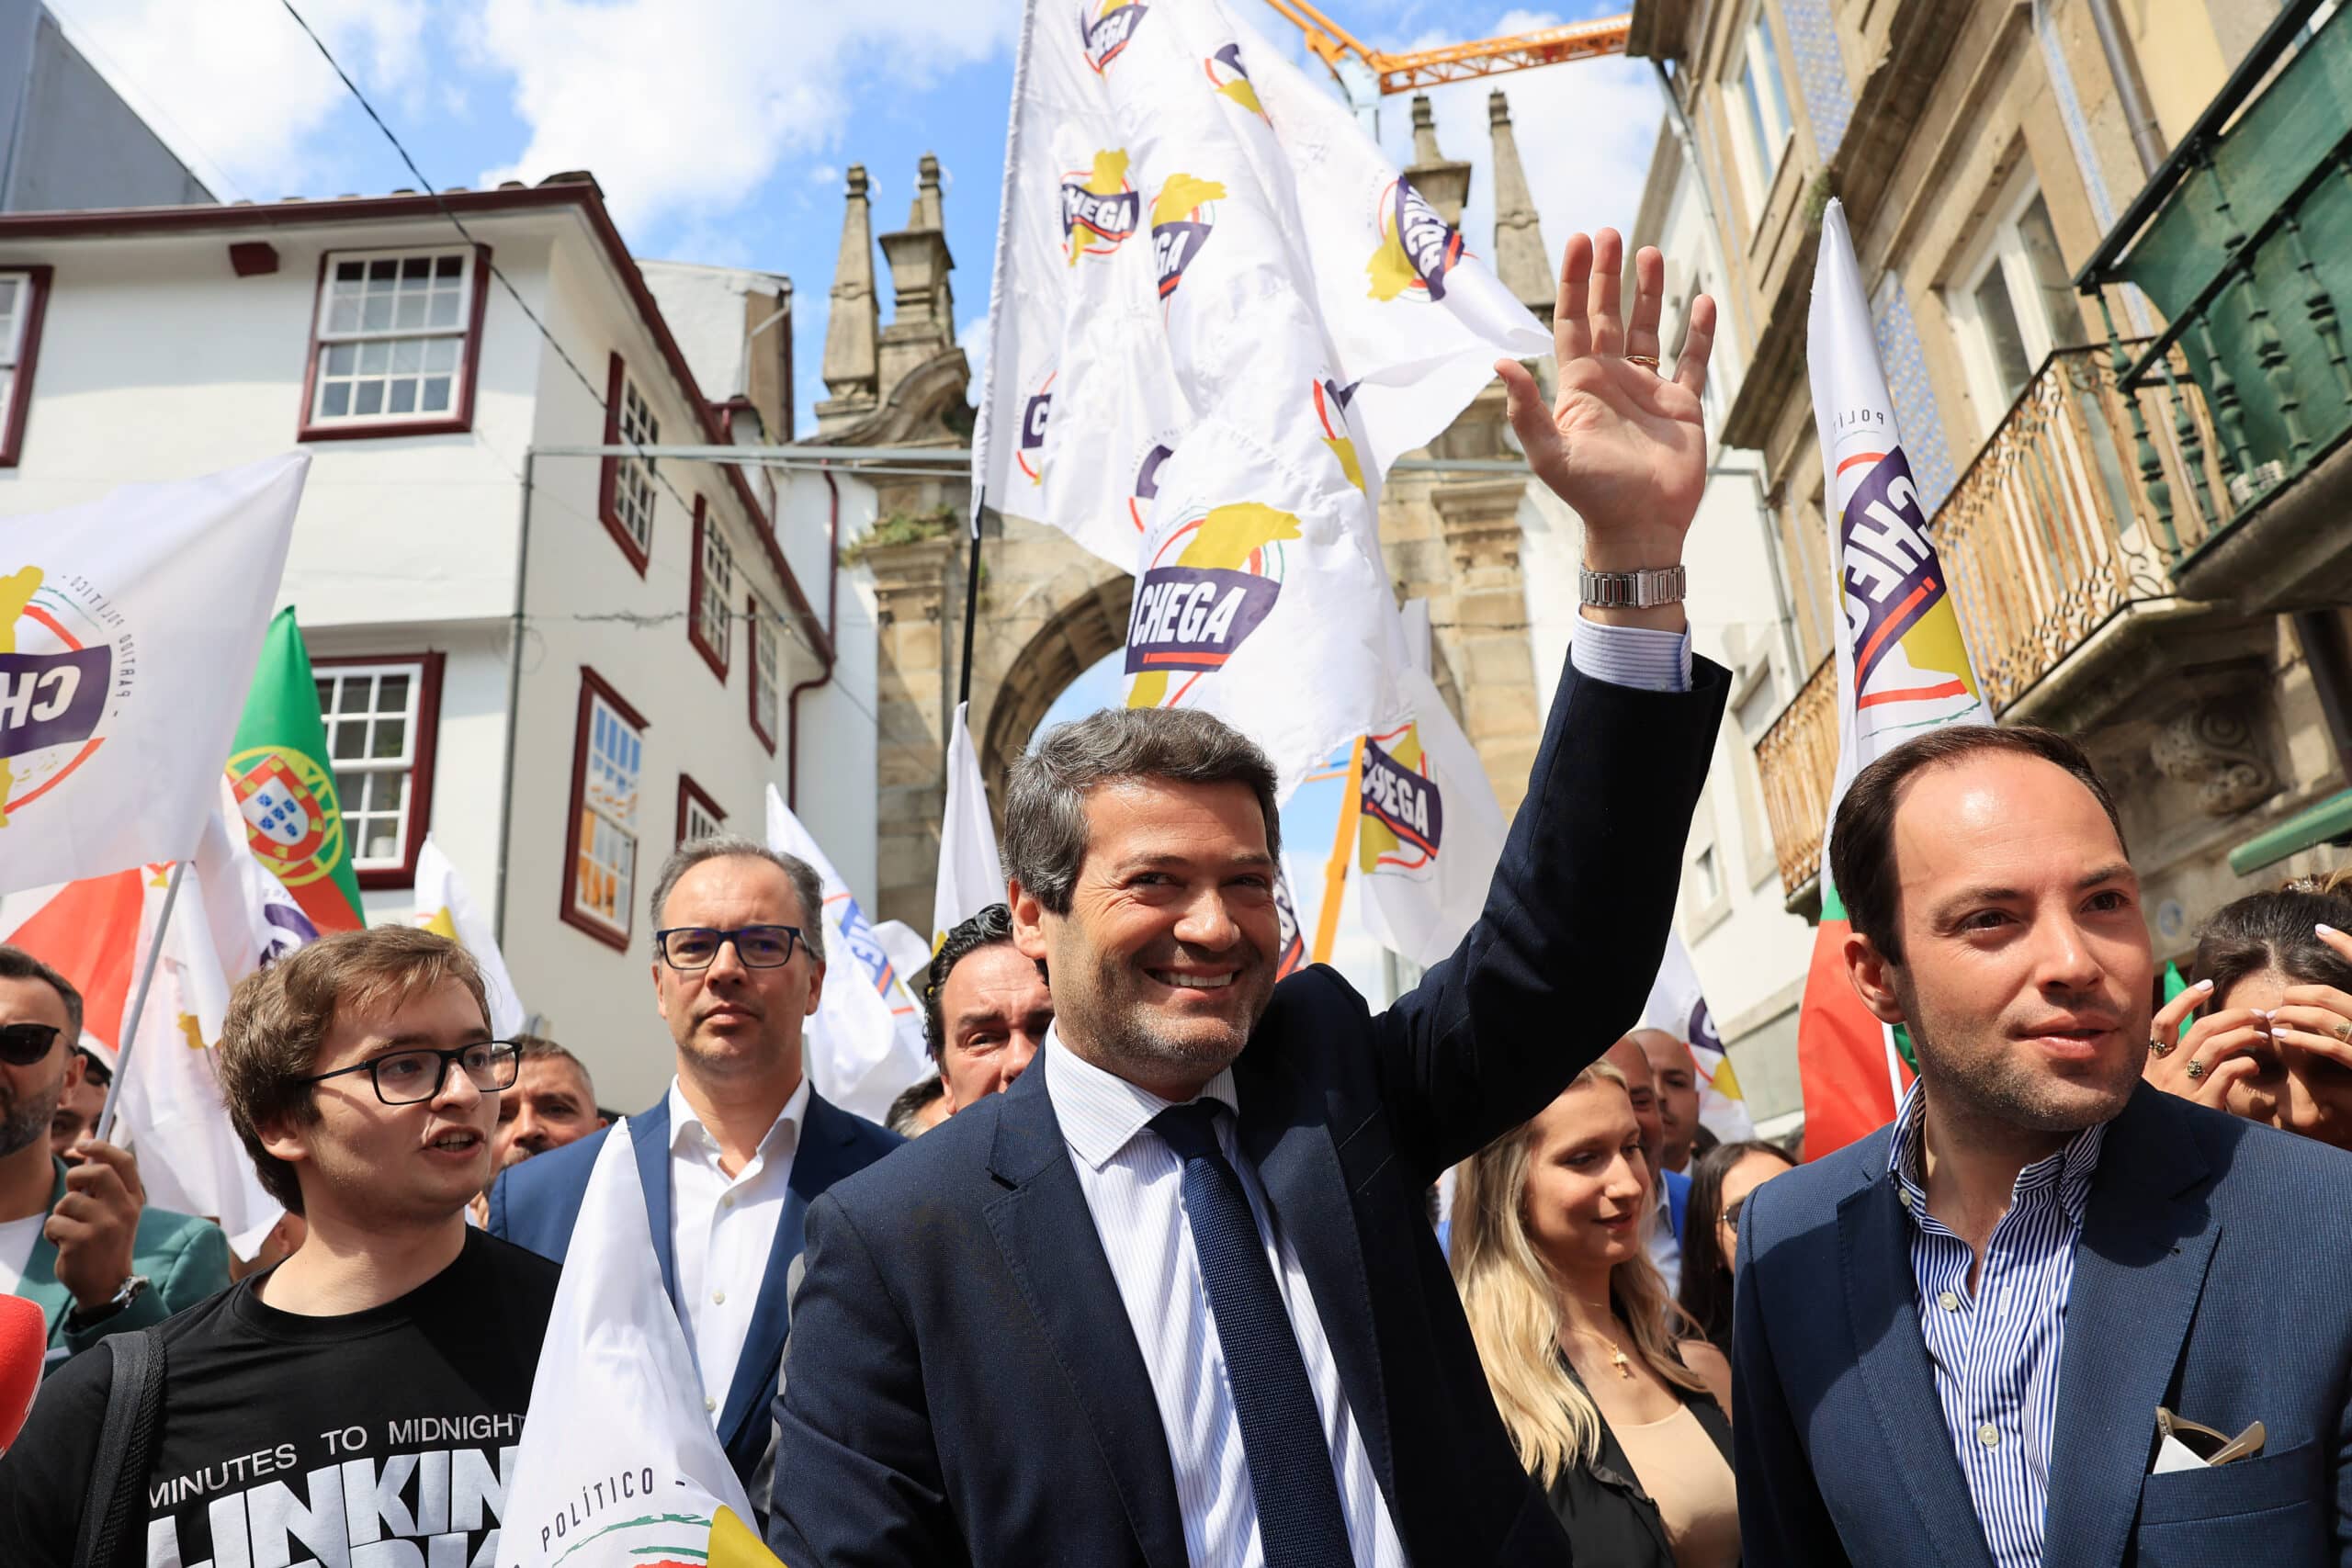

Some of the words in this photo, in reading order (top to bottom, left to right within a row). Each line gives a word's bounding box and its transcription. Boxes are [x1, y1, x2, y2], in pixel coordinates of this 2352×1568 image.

[1067, 186, 1131, 232] HEGA
[1131, 581, 1248, 648] CHEGA
[149, 1443, 298, 1509] MINUTES
[321, 1426, 368, 1455] TO
[540, 1467, 654, 1552] POLÍTICO
